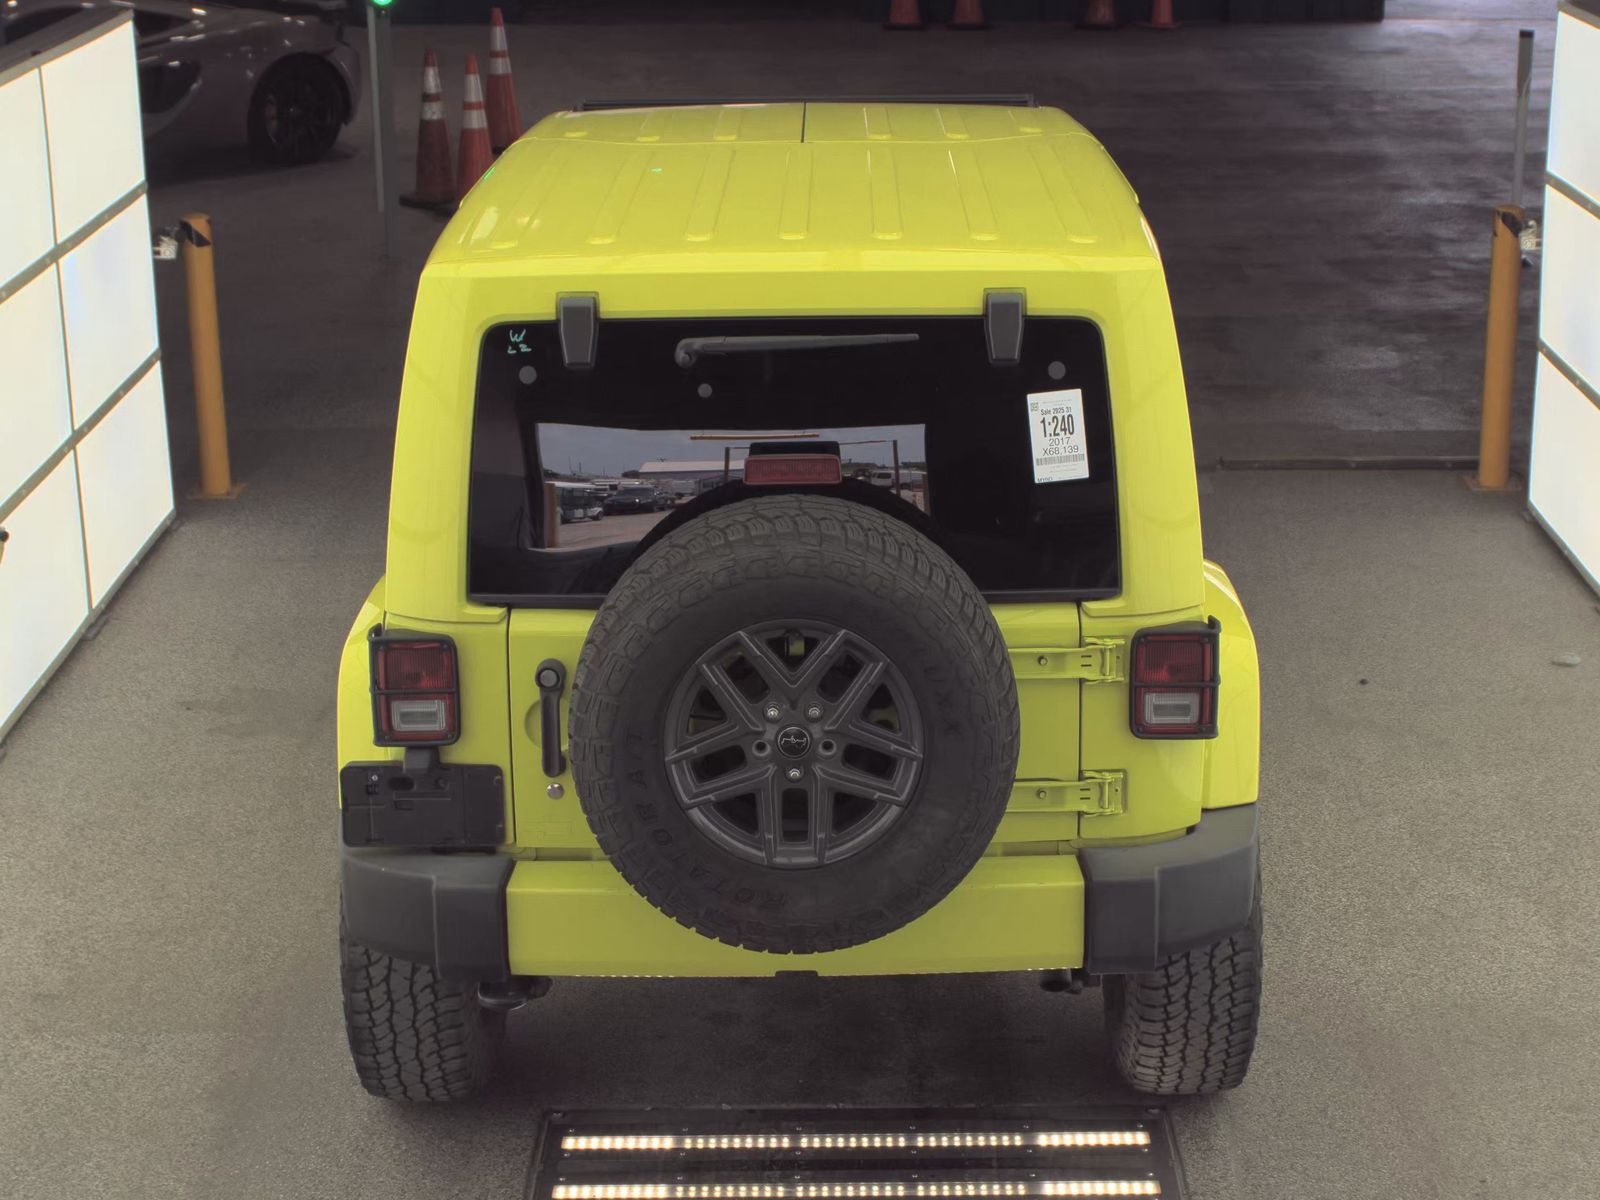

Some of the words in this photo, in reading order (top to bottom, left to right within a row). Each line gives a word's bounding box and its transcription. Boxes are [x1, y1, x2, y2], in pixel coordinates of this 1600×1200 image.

[1040, 408, 1051, 416] Sale
[1052, 407, 1065, 415] 2025
[1040, 414, 1075, 437] 1:240
[1049, 437, 1071, 447] 2017
[1043, 445, 1079, 457] X68,139
